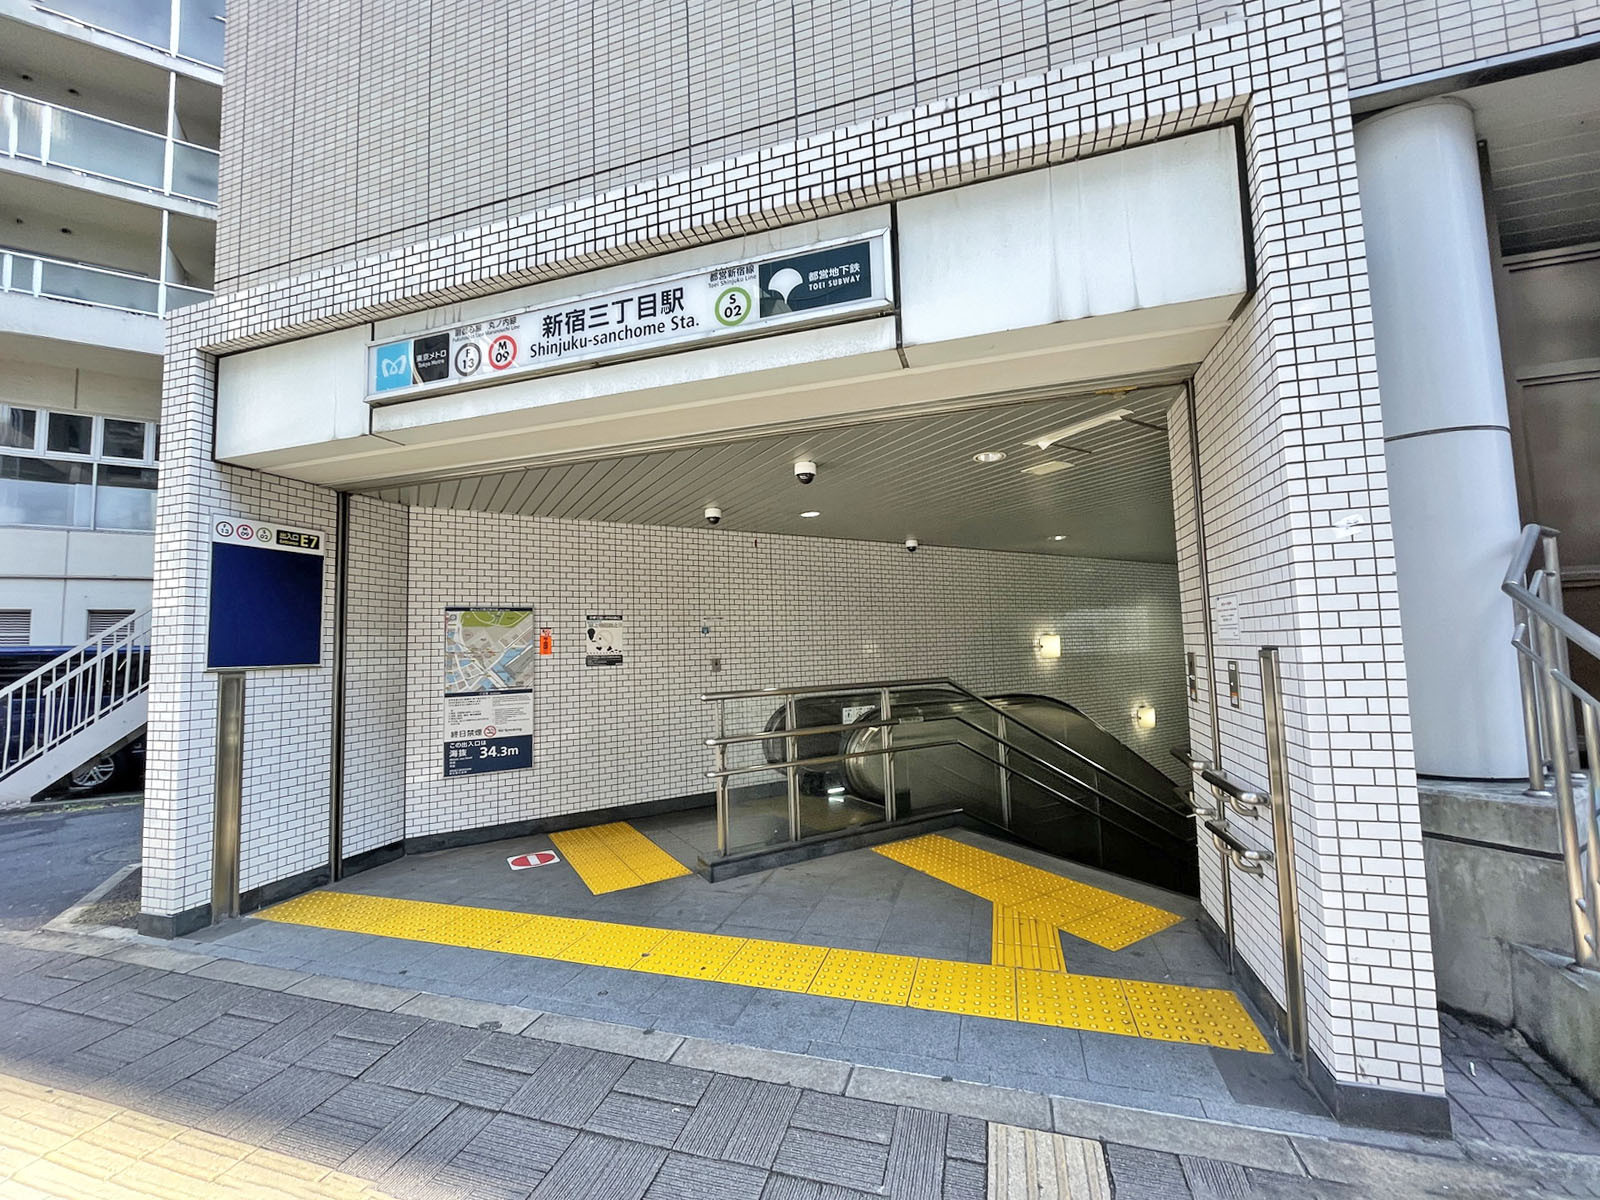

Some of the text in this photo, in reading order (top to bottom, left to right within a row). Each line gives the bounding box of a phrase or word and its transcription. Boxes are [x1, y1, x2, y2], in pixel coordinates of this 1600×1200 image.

[710, 264, 755, 282] 都営新宿線
[809, 262, 860, 281] 都営地下鉄
[808, 274, 860, 291] TOEI SUBWAY
[729, 294, 737, 304] S
[542, 287, 685, 339] 新宿三丁目駅
[724, 305, 742, 318] 02
[530, 314, 700, 358] Shinjuku-sanchome Sta.
[498, 341, 507, 351] M
[415, 349, 447, 362] 東京メトロ
[465, 348, 471, 358] F
[495, 351, 510, 363] 09
[463, 358, 475, 369] 13
[300, 534, 318, 548] E7
[450, 729, 482, 738] 終日禁煙
[449, 740, 486, 749] この出入口は
[449, 748, 467, 758] 海抜
[479, 746, 519, 759] 34.3m
